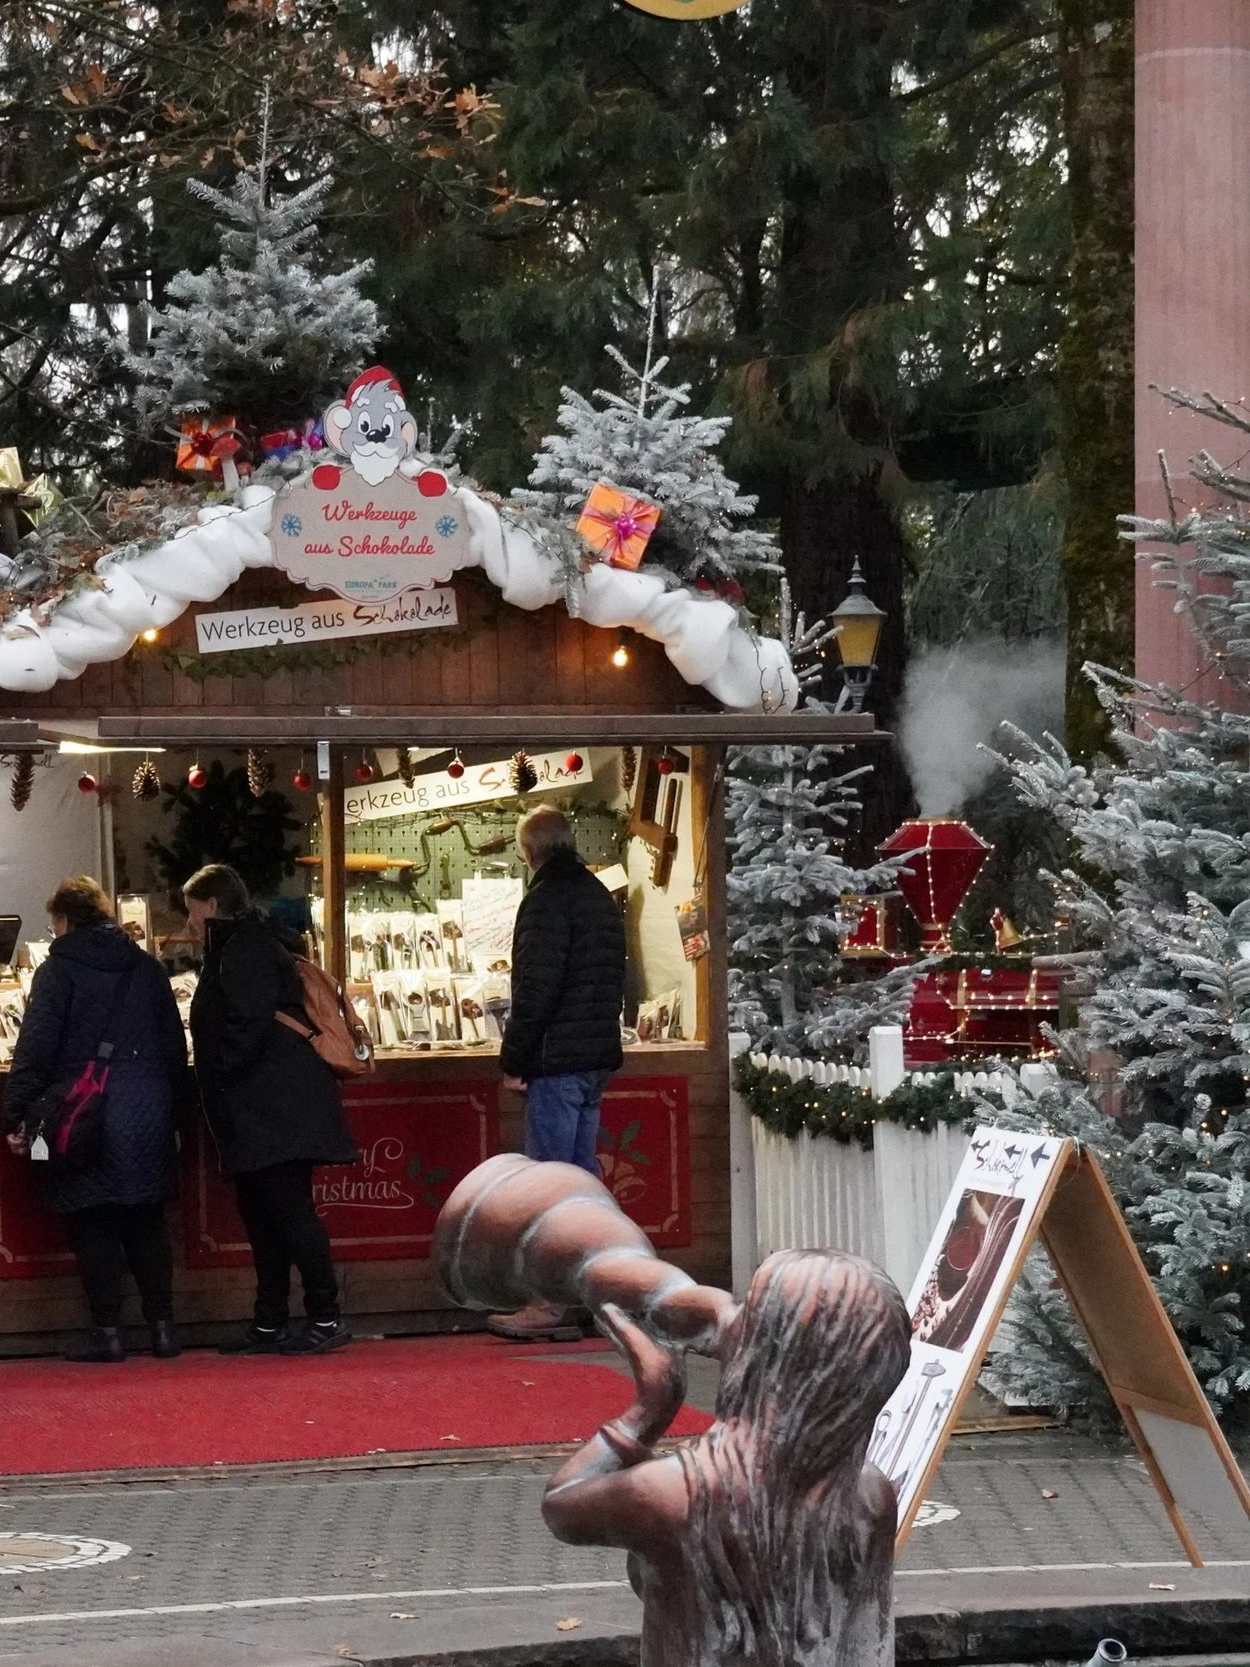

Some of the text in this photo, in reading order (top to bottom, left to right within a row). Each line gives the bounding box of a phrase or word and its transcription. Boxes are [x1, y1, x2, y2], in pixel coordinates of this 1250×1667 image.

[322, 500, 418, 529] Werkzeuge
[304, 535, 435, 557] aus Schokolade
[345, 581, 398, 589] EUROPA PARK
[201, 596, 452, 641] Werkzeug aus Schokolade
[347, 786, 429, 815] erkzeug
[435, 779, 471, 798] aus
[311, 1176, 410, 1205] ristmas
